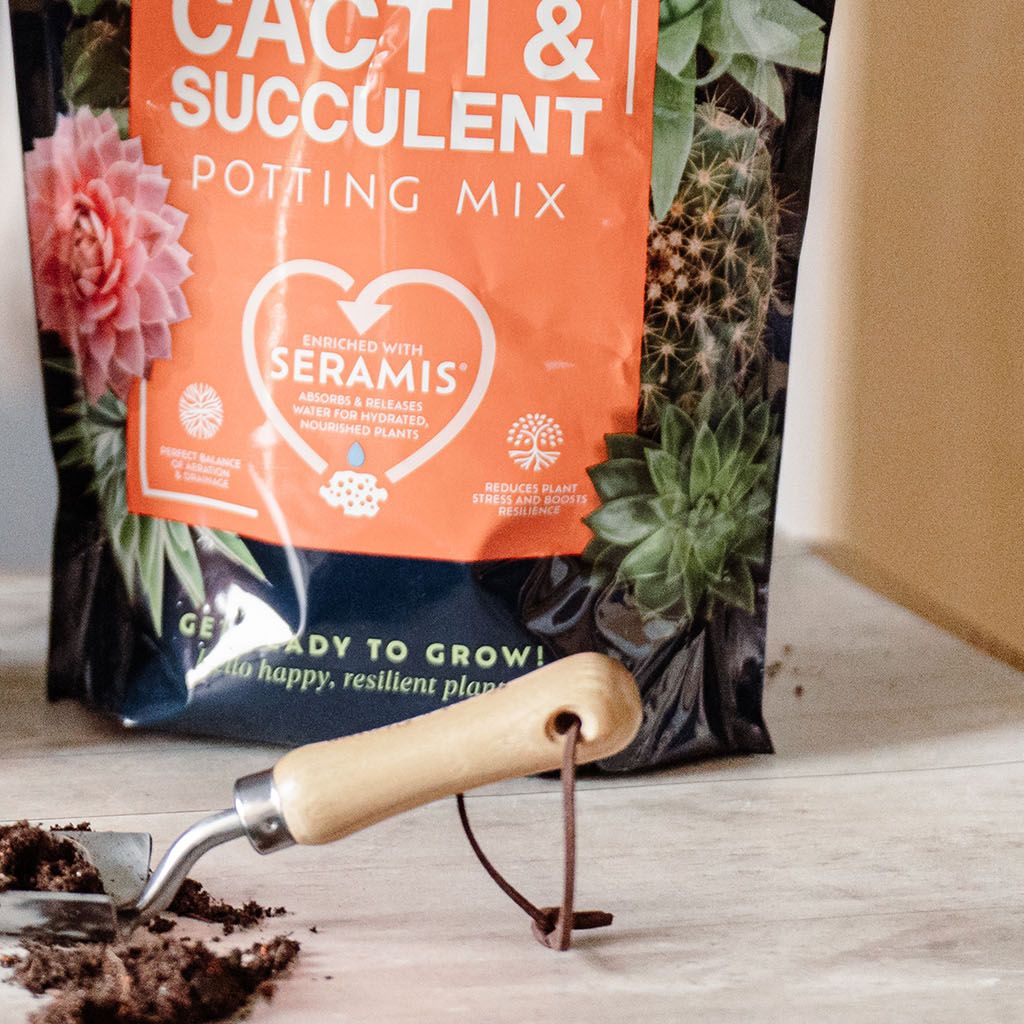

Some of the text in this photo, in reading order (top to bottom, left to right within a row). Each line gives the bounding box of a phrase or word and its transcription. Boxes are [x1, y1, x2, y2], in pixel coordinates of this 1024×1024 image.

[170, 65, 602, 156] SUCCULENT
[192, 154, 566, 219] POTTING MIX
[302, 334, 423, 356] ENRICHED WITH
[298, 392, 351, 407] ABSORBS
[365, 397, 423, 412] RELEASES
[293, 404, 429, 427] WATER FOR HYDRATED,
[299, 419, 420, 440] NOURISHED PLANTS
[484, 482, 578, 493] REDUCES PLANT
[472, 494, 587, 505] STRESS AND BOOSTS
[498, 506, 561, 516] RESILIENCE
[367, 638, 409, 663] TO
[425, 643, 544, 668] GROW!
[258, 658, 336, 692] happy,
[343, 669, 437, 693] resilient
